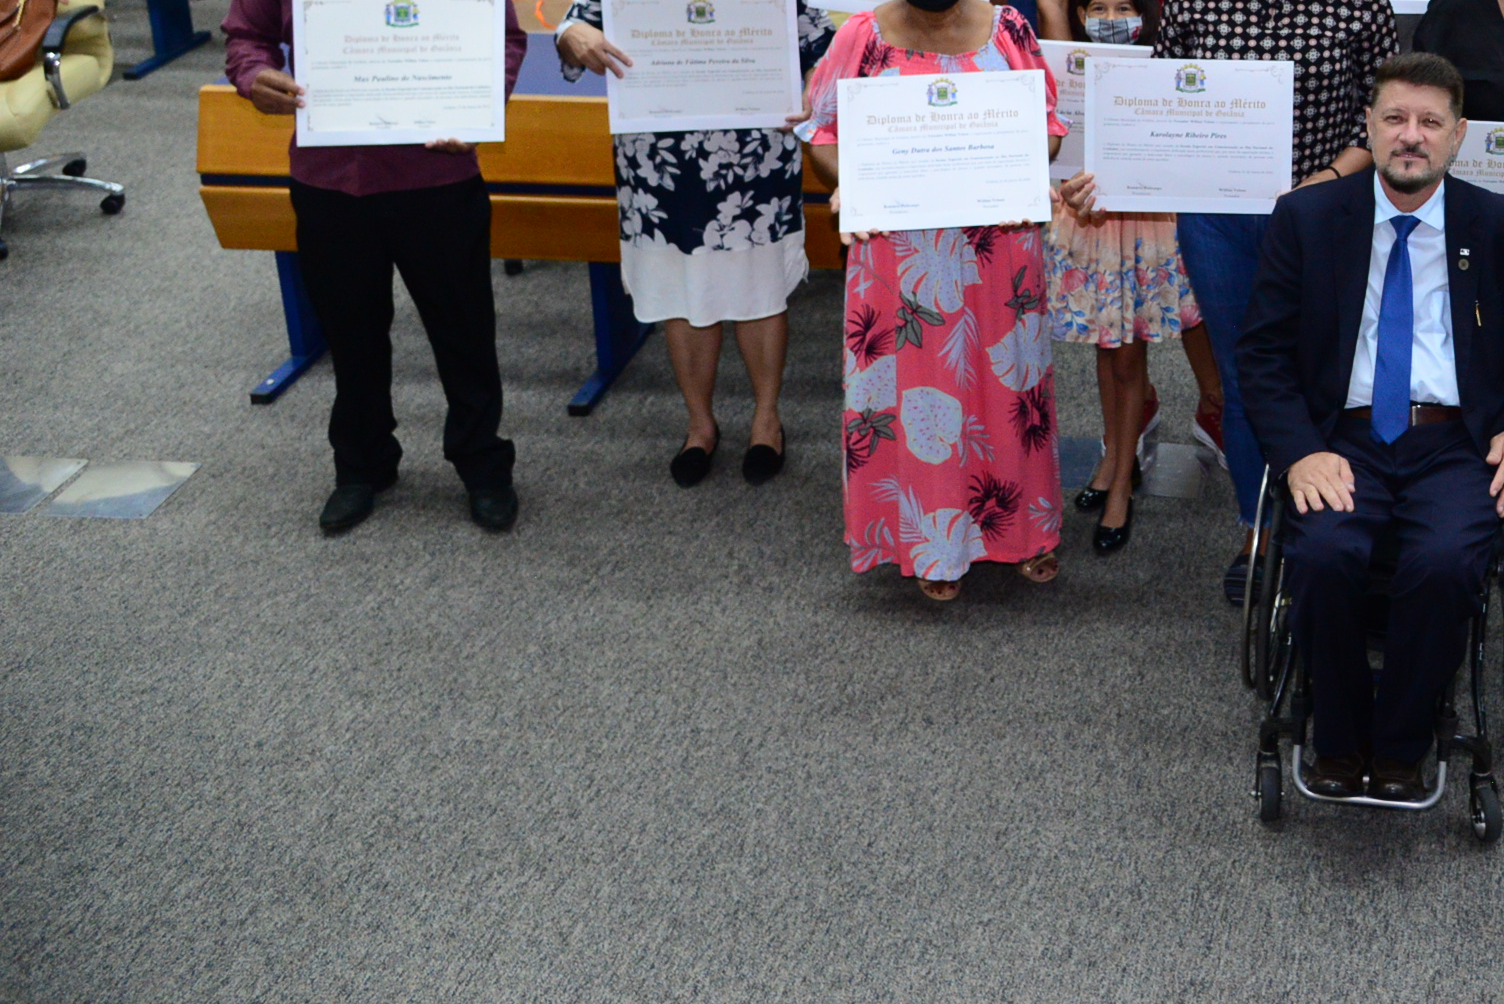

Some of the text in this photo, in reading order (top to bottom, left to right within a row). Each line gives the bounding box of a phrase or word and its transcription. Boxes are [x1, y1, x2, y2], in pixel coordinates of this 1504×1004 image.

[631, 29, 673, 39] Diploma
[676, 29, 686, 37] de
[690, 28, 721, 37] Honra
[739, 27, 772, 37] Mérito
[1113, 96, 1158, 108] Diploma
[1163, 98, 1173, 107] de
[1177, 98, 1211, 109] Honra
[1230, 99, 1266, 109] Mérito
[867, 115, 911, 125] Diploma
[915, 113, 925, 123] de
[930, 111, 964, 122] Honra
[984, 109, 1019, 119] Mérito
[1166, 109, 1203, 117] Municipal
[1216, 110, 1245, 118] Goiânia
[888, 125, 917, 133] Câmara
[920, 123, 957, 132] Municipal
[969, 121, 998, 129] Goiânia
[1150, 131, 1183, 139] Karolayne
[1185, 131, 1209, 139] Ribeiro
[911, 146, 930, 154] Dutra
[1472, 158, 1483, 168] de
